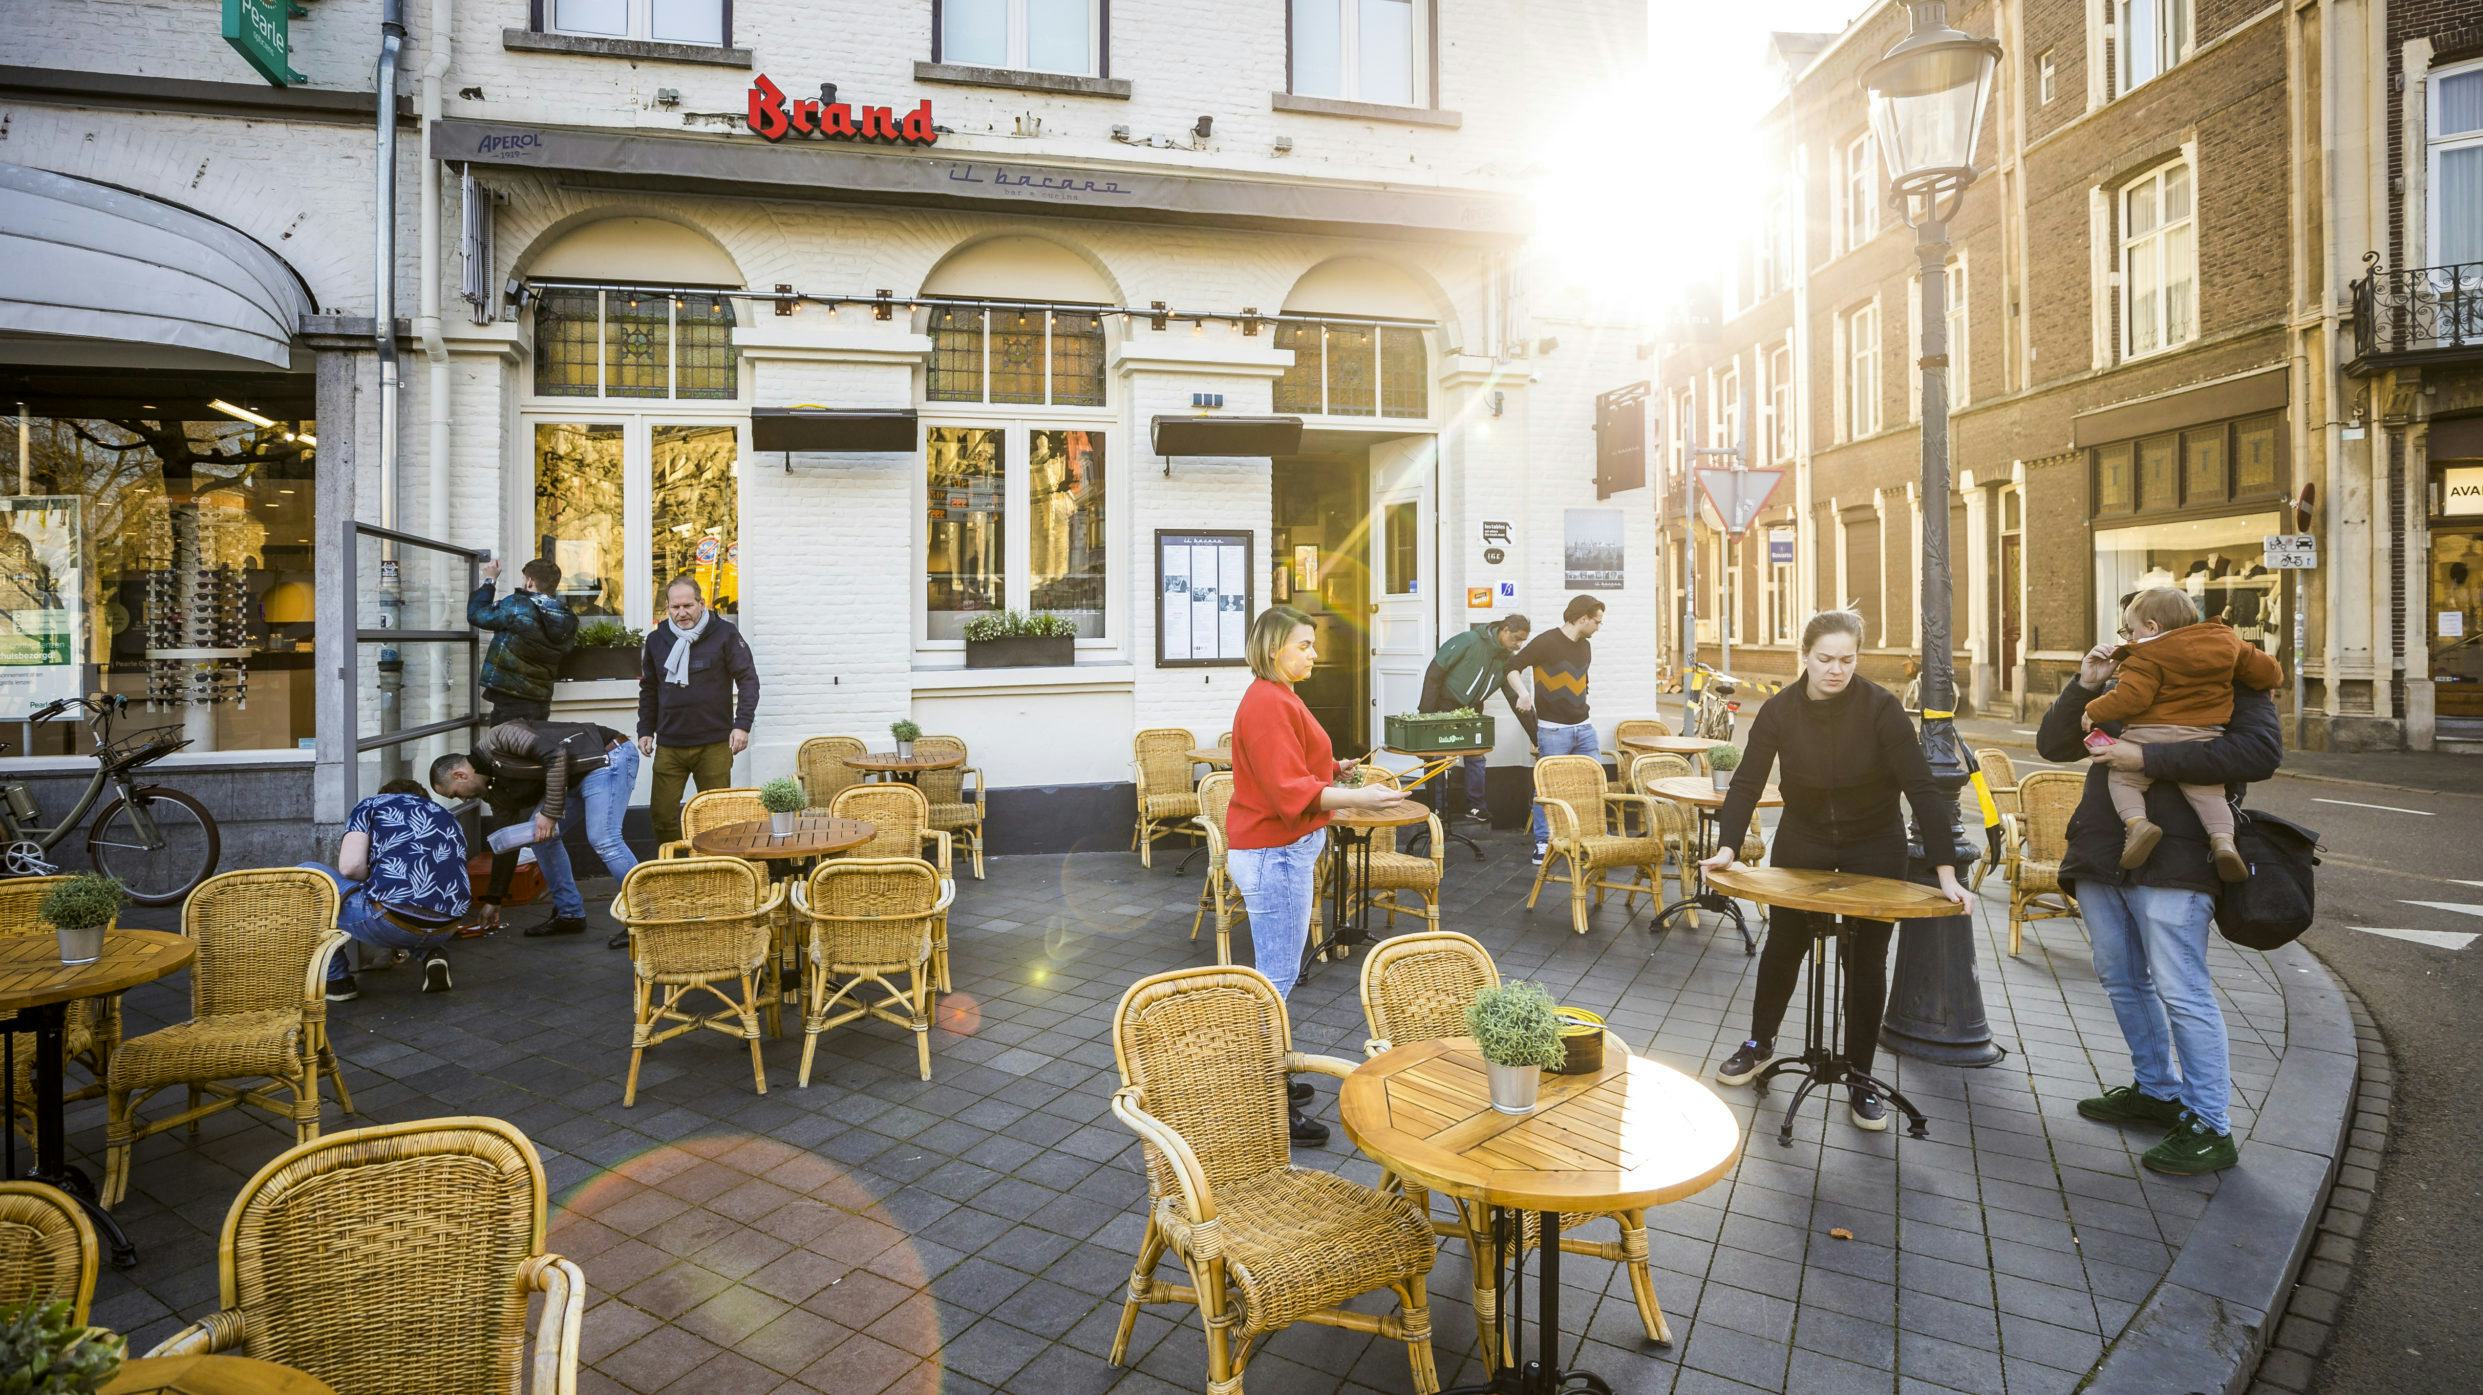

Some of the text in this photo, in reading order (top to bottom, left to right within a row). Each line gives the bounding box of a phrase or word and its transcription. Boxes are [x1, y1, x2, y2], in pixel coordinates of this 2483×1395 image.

[242, 0, 285, 54] Pearle
[747, 73, 938, 147] Brand
[477, 133, 543, 154] APEROL
[994, 167, 1132, 194] bacaro
[2450, 485, 2483, 497] AVA
[30, 701, 52, 709] Pearl
